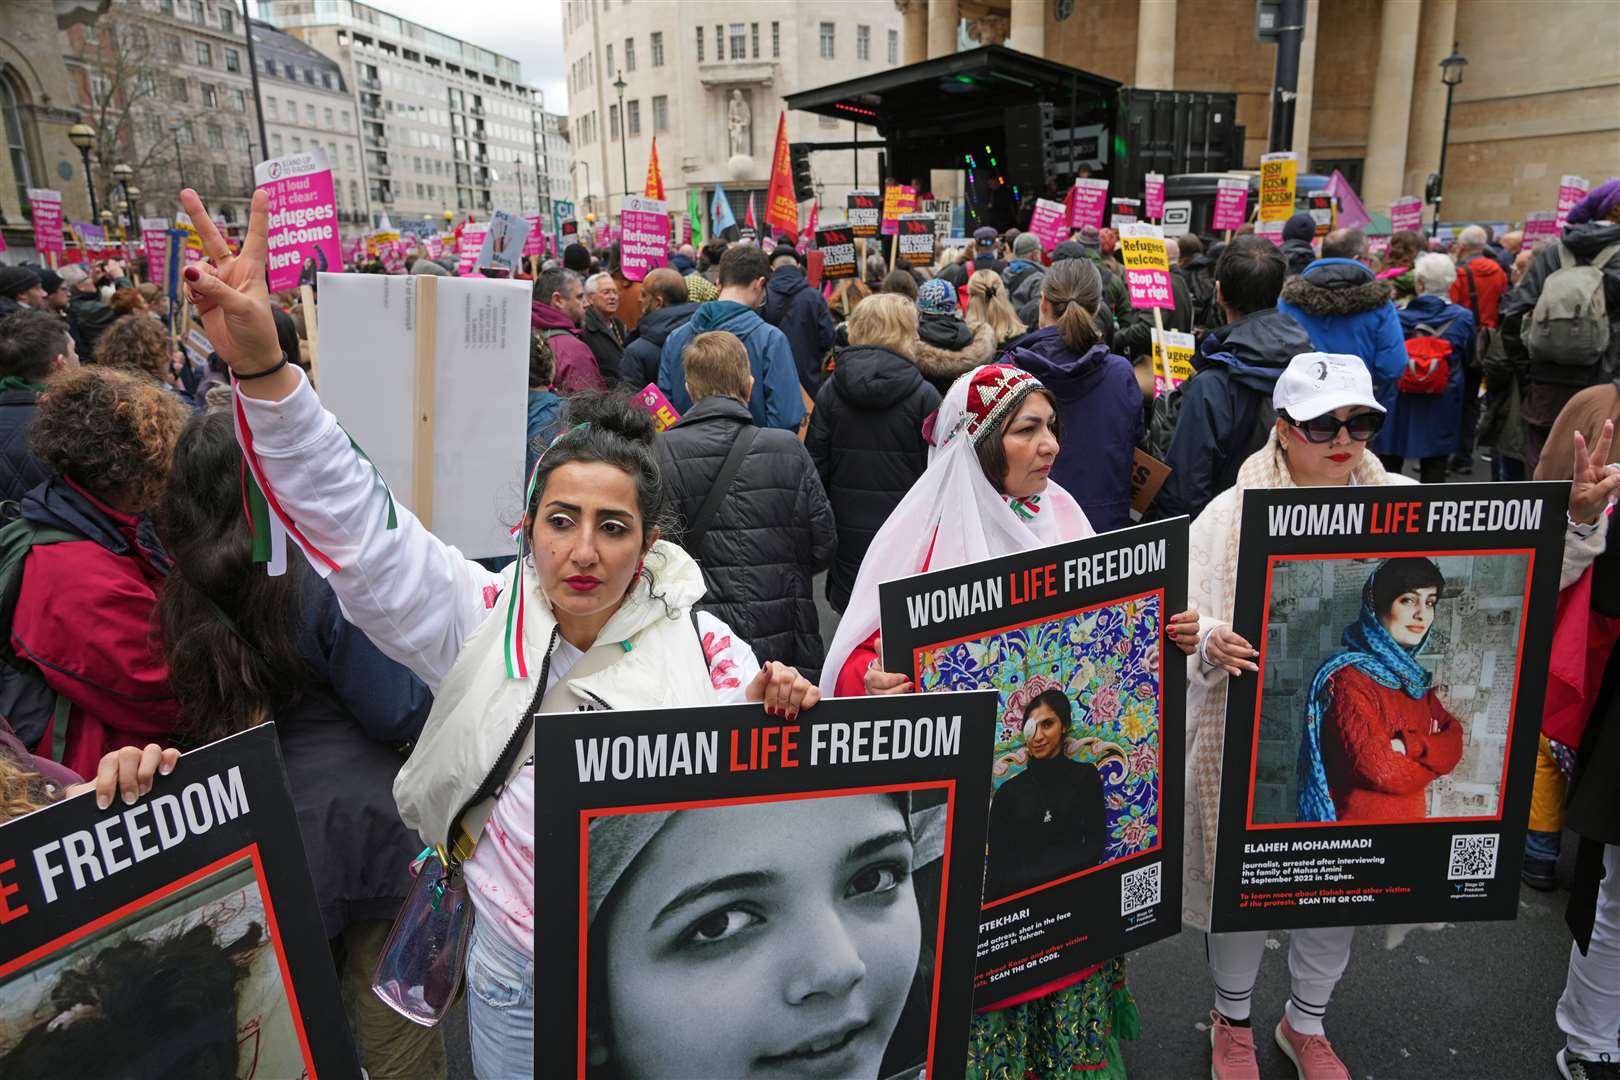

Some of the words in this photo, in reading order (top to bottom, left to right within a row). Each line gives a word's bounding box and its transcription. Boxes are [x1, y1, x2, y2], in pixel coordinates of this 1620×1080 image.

[623, 228, 666, 247] Refugees
[623, 241, 665, 257] welcome
[1123, 240, 1165, 254] Refugees
[268, 250, 301, 270] here
[623, 254, 648, 268] here
[1126, 254, 1166, 266] welcome
[1128, 271, 1153, 287] Stop
[1154, 271, 1167, 286] the
[1131, 285, 1146, 299] far
[1147, 285, 1169, 301] right
[1268, 503, 1365, 537] WOMAN
[1370, 502, 1423, 535] LIFE
[1427, 499, 1544, 533] FREEDOM
[906, 576, 1003, 630] WOMAN
[1009, 563, 1058, 606] LIFE
[1064, 538, 1167, 593] FREEDOM
[575, 731, 719, 783] WOMAN
[730, 725, 801, 772] LIFE
[810, 715, 962, 766] FREEDOM
[32, 765, 250, 904] FREEDOM
[1244, 842, 1288, 854] ELAHEH
[1291, 838, 1372, 851] MOHAMMADI
[1242, 860, 1280, 871] journalist,
[1282, 858, 1315, 868] arrested
[1316, 857, 1336, 866] after
[1337, 855, 1385, 865] interviewing
[1242, 869, 1255, 877] the
[1256, 867, 1281, 877] family
[1282, 867, 1292, 875] of
[1292, 865, 1318, 874] Mahsa
[1319, 864, 1343, 873] Amini
[1250, 875, 1293, 886] September
[1294, 874, 1313, 883] 2022
[1314, 873, 1321, 881] in
[1297, 896, 1320, 905] SCAN
[1321, 895, 1337, 904] THE
[1337, 895, 1351, 903] QR
[1351, 894, 1376, 903] CODE.
[979, 908, 1030, 934] FTEKHARI
[990, 931, 1018, 945] actress,
[1019, 924, 1034, 936] shot
[1035, 920, 1043, 930] in
[1043, 916, 1056, 927] the
[1056, 911, 1072, 921] face
[976, 948, 990, 958] ber
[990, 941, 1010, 953] 2022
[1010, 937, 1018, 946] in
[1019, 929, 1046, 942] Tehran.
[990, 969, 1011, 983] SCAN
[1011, 964, 1025, 975] THE
[1026, 959, 1038, 969] QR
[1038, 951, 1061, 965] CODE.
